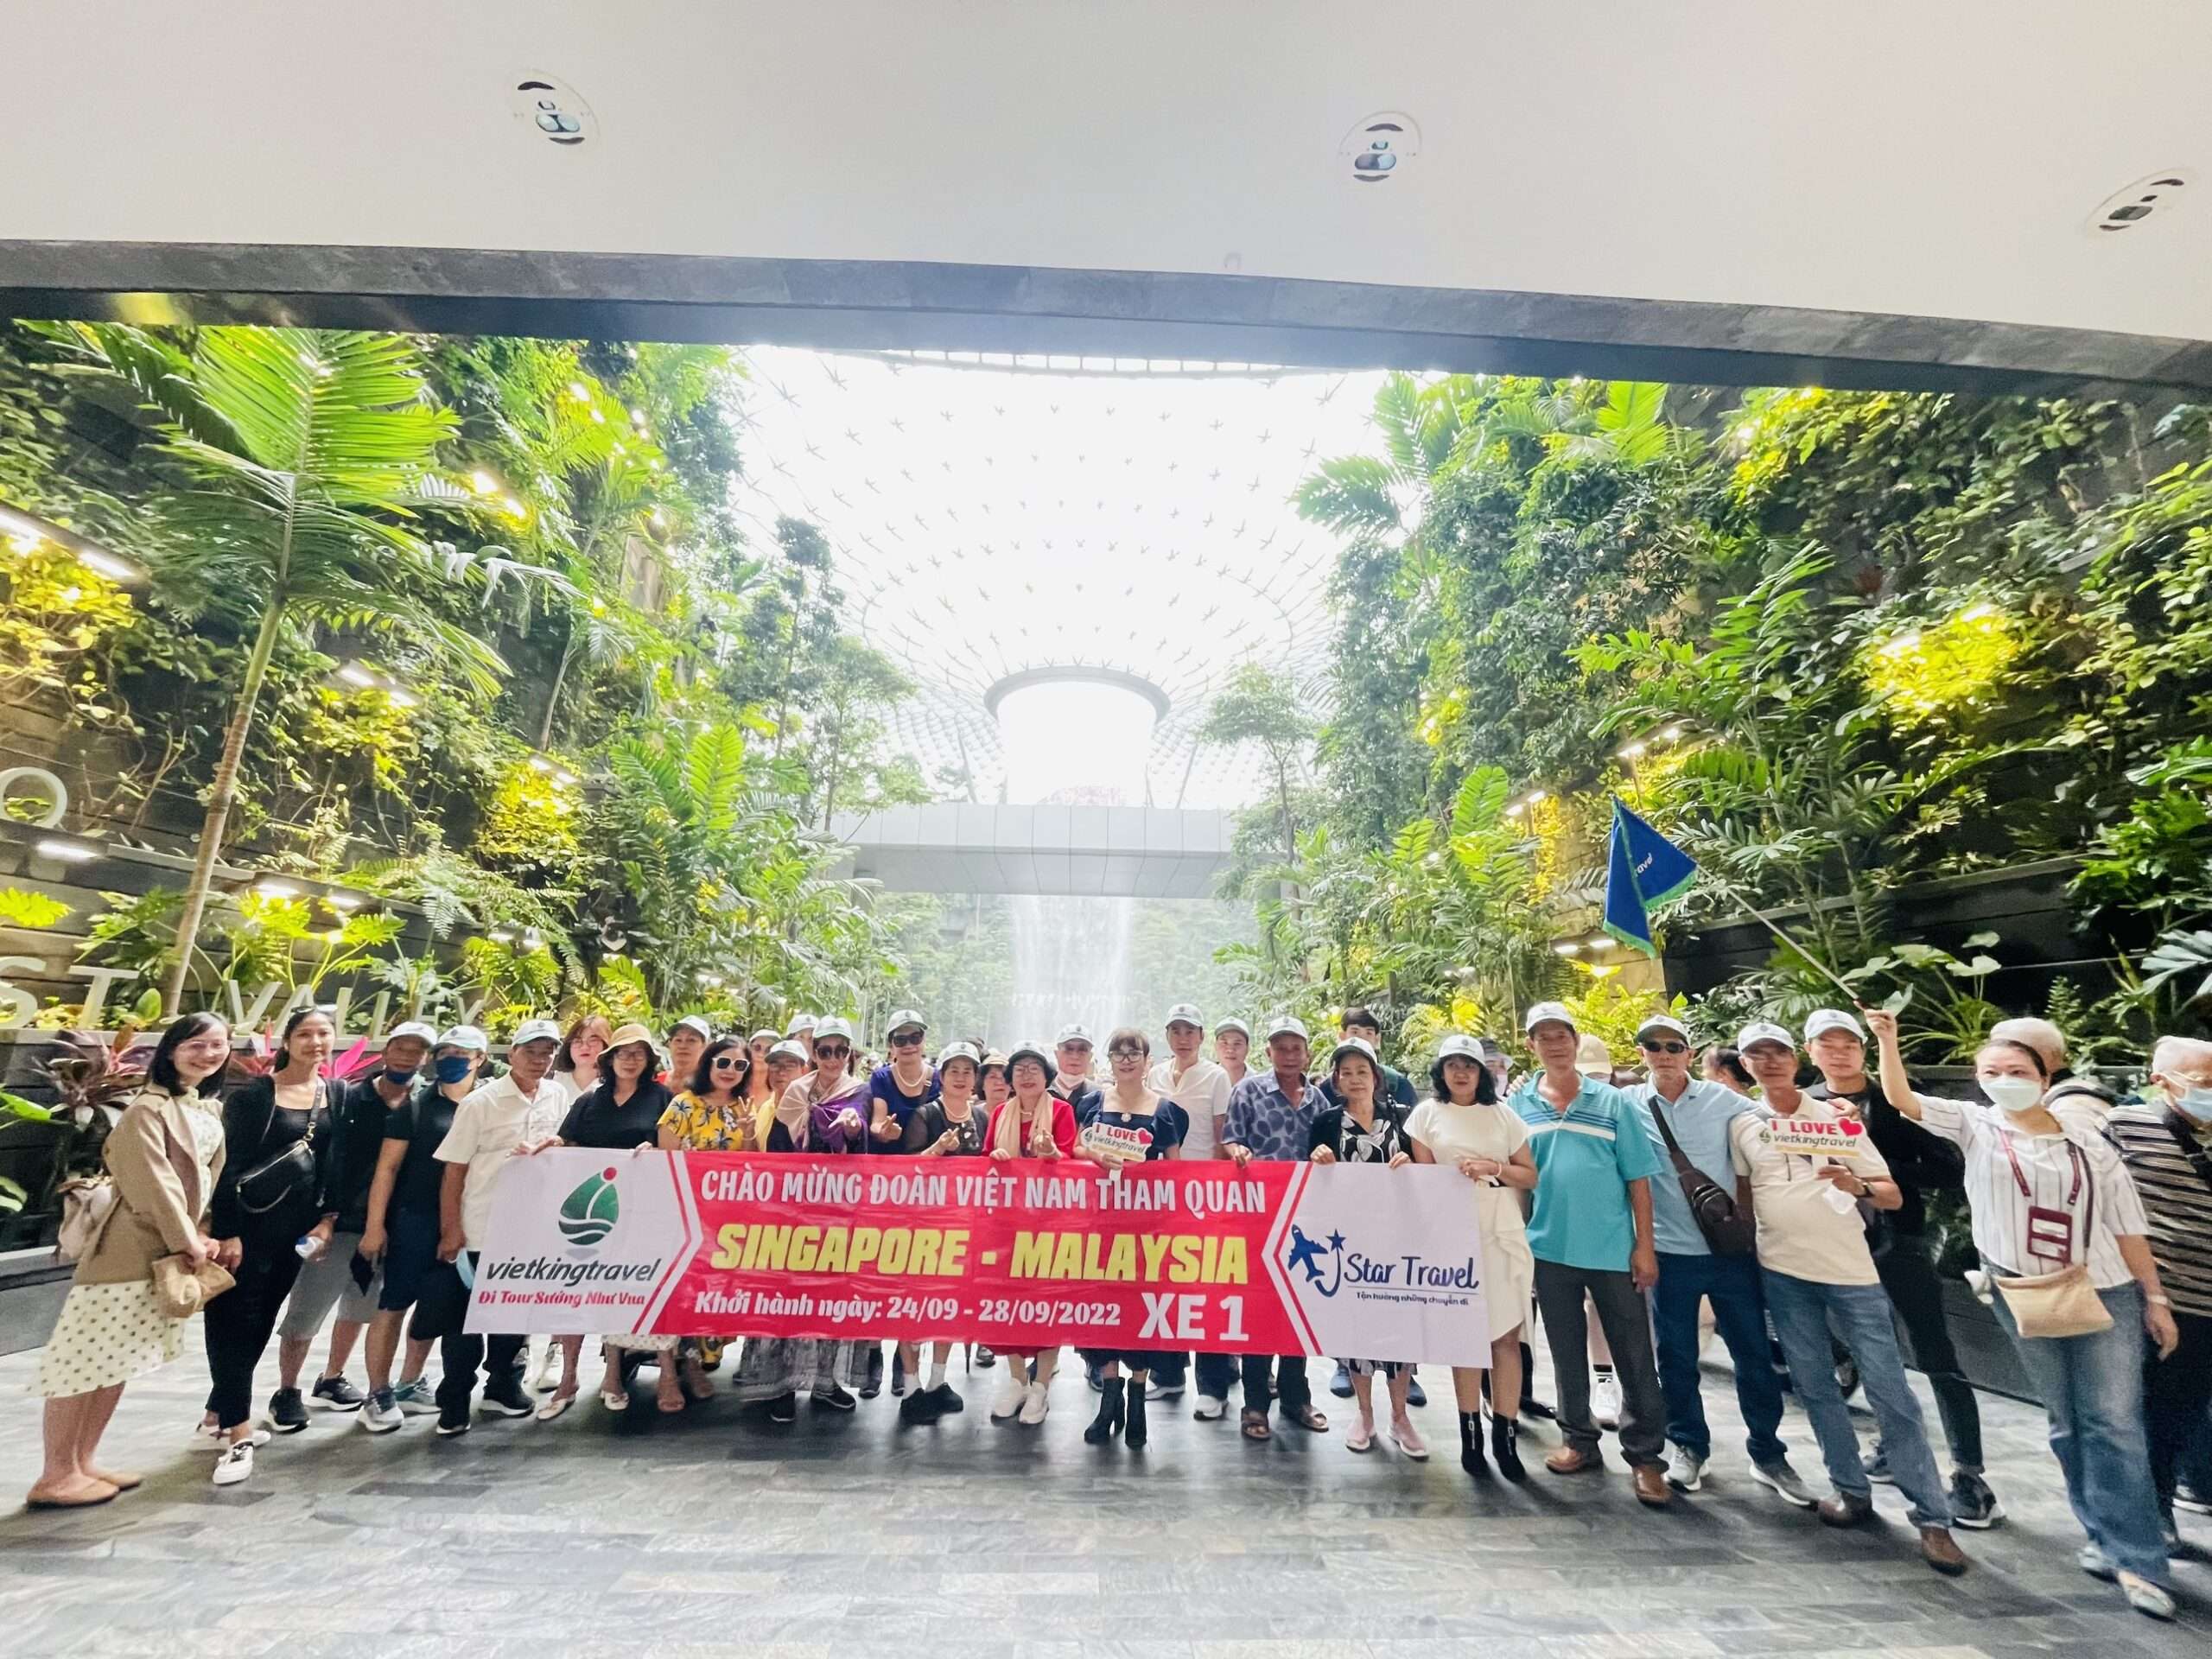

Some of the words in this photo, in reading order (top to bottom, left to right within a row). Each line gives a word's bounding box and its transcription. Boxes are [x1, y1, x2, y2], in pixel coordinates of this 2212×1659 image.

[1095, 1123, 1100, 1134] I
[1107, 1126, 1137, 1142] LOVE
[1771, 1120, 1778, 1131] I
[1789, 1121, 1838, 1135] LOVE
[1774, 1134, 1857, 1147] vietkingtravel
[1094, 1135, 1146, 1154] vietkingtravel
[701, 1162, 774, 1202] CHÀO
[781, 1163, 862, 1205] MỪNG
[869, 1166, 948, 1206] ĐOÀN
[956, 1166, 1018, 1215] VIỆT
[1025, 1176, 1087, 1210] NAM
[1095, 1178, 1176, 1212] THAM
[1185, 1180, 1266, 1220] QUAN
[710, 1223, 970, 1276] SINGAPORE
[1009, 1230, 1249, 1285] MALAYSIA
[486, 1255, 663, 1287] vietkingtravel
[1344, 1253, 1397, 1284] Star
[1401, 1255, 1480, 1289] Travel
[478, 1290, 497, 1305] Đi
[500, 1291, 534, 1305] Tour
[619, 1292, 645, 1305] Vua
[694, 1288, 752, 1314] Khởi
[753, 1294, 814, 1317] hành
[817, 1294, 883, 1323] ngày:
[887, 1296, 959, 1323] 24/09
[977, 1299, 1121, 1327] 28/09/2022
[1137, 1292, 1208, 1340] XE
[1219, 1295, 1249, 1341] 1
